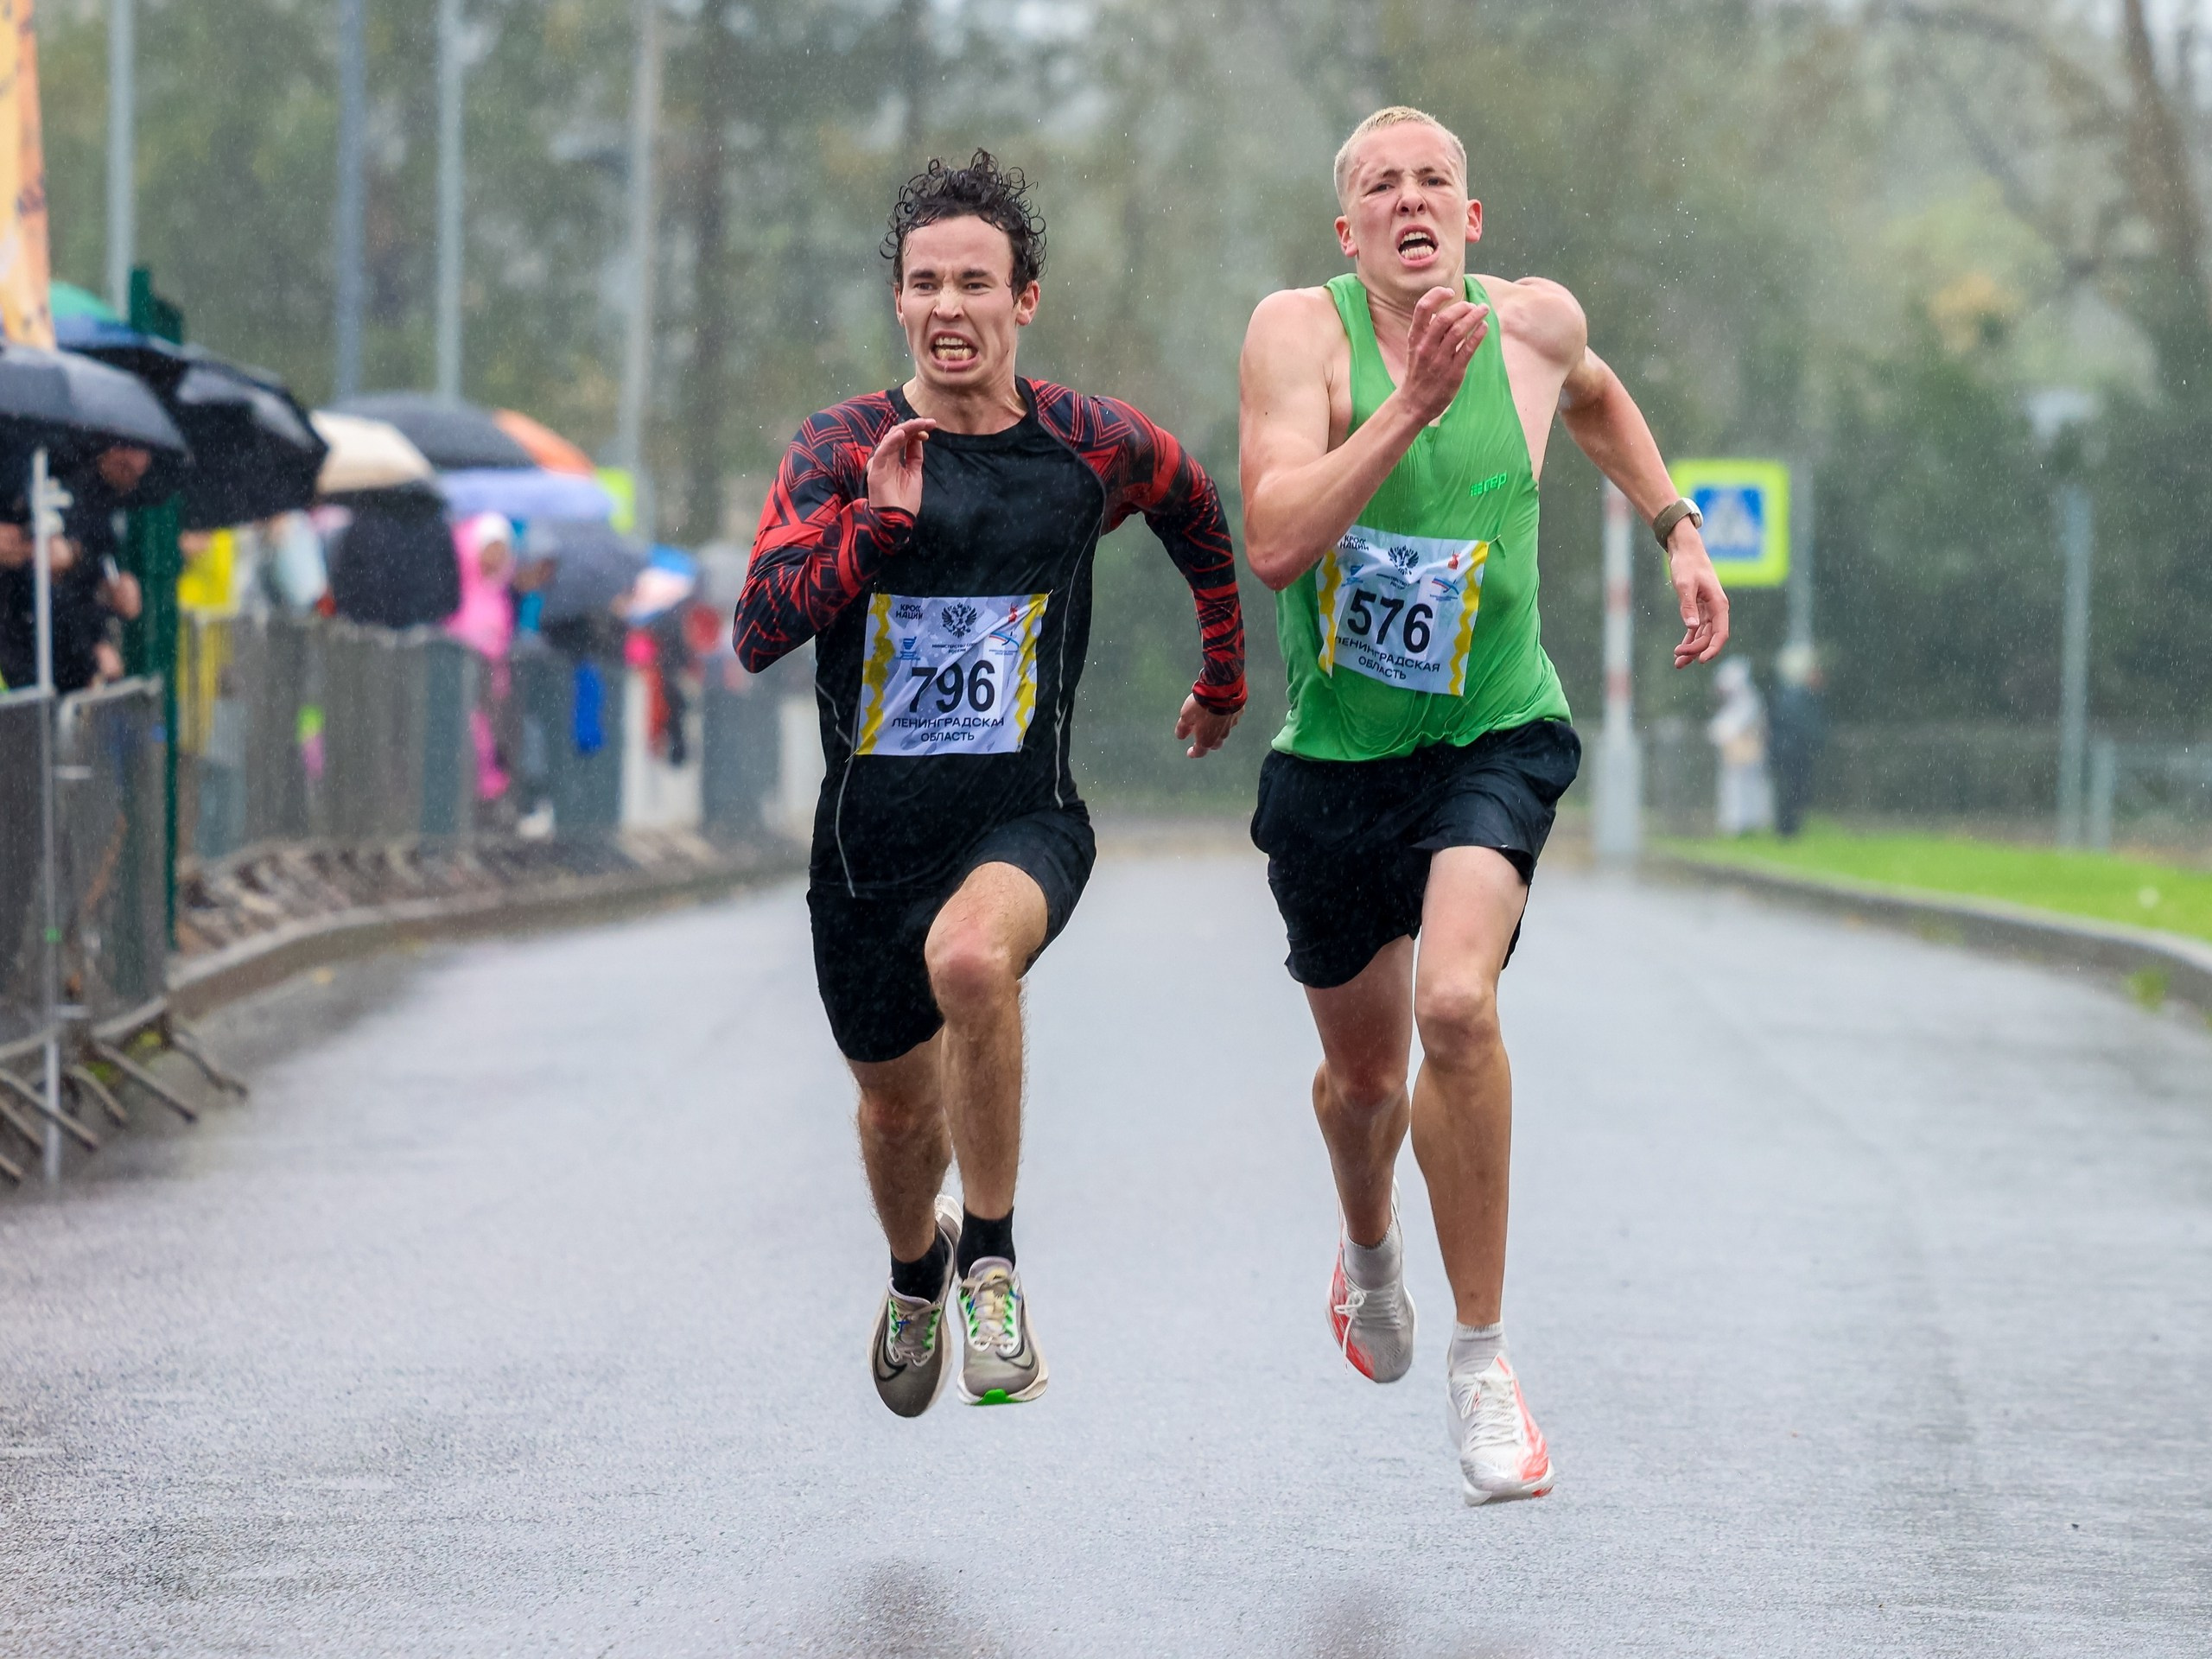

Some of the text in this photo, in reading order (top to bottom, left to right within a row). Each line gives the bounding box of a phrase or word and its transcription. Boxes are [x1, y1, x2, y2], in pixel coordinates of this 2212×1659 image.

[1346, 588, 1433, 653] 576
[1335, 636, 1440, 673] ЛЕНИНГРАДСКАЯ
[1357, 655, 1407, 680] ОБЛАСТЬ
[908, 659, 995, 713] 796
[920, 731, 975, 742] ОБЛАСТЬ
